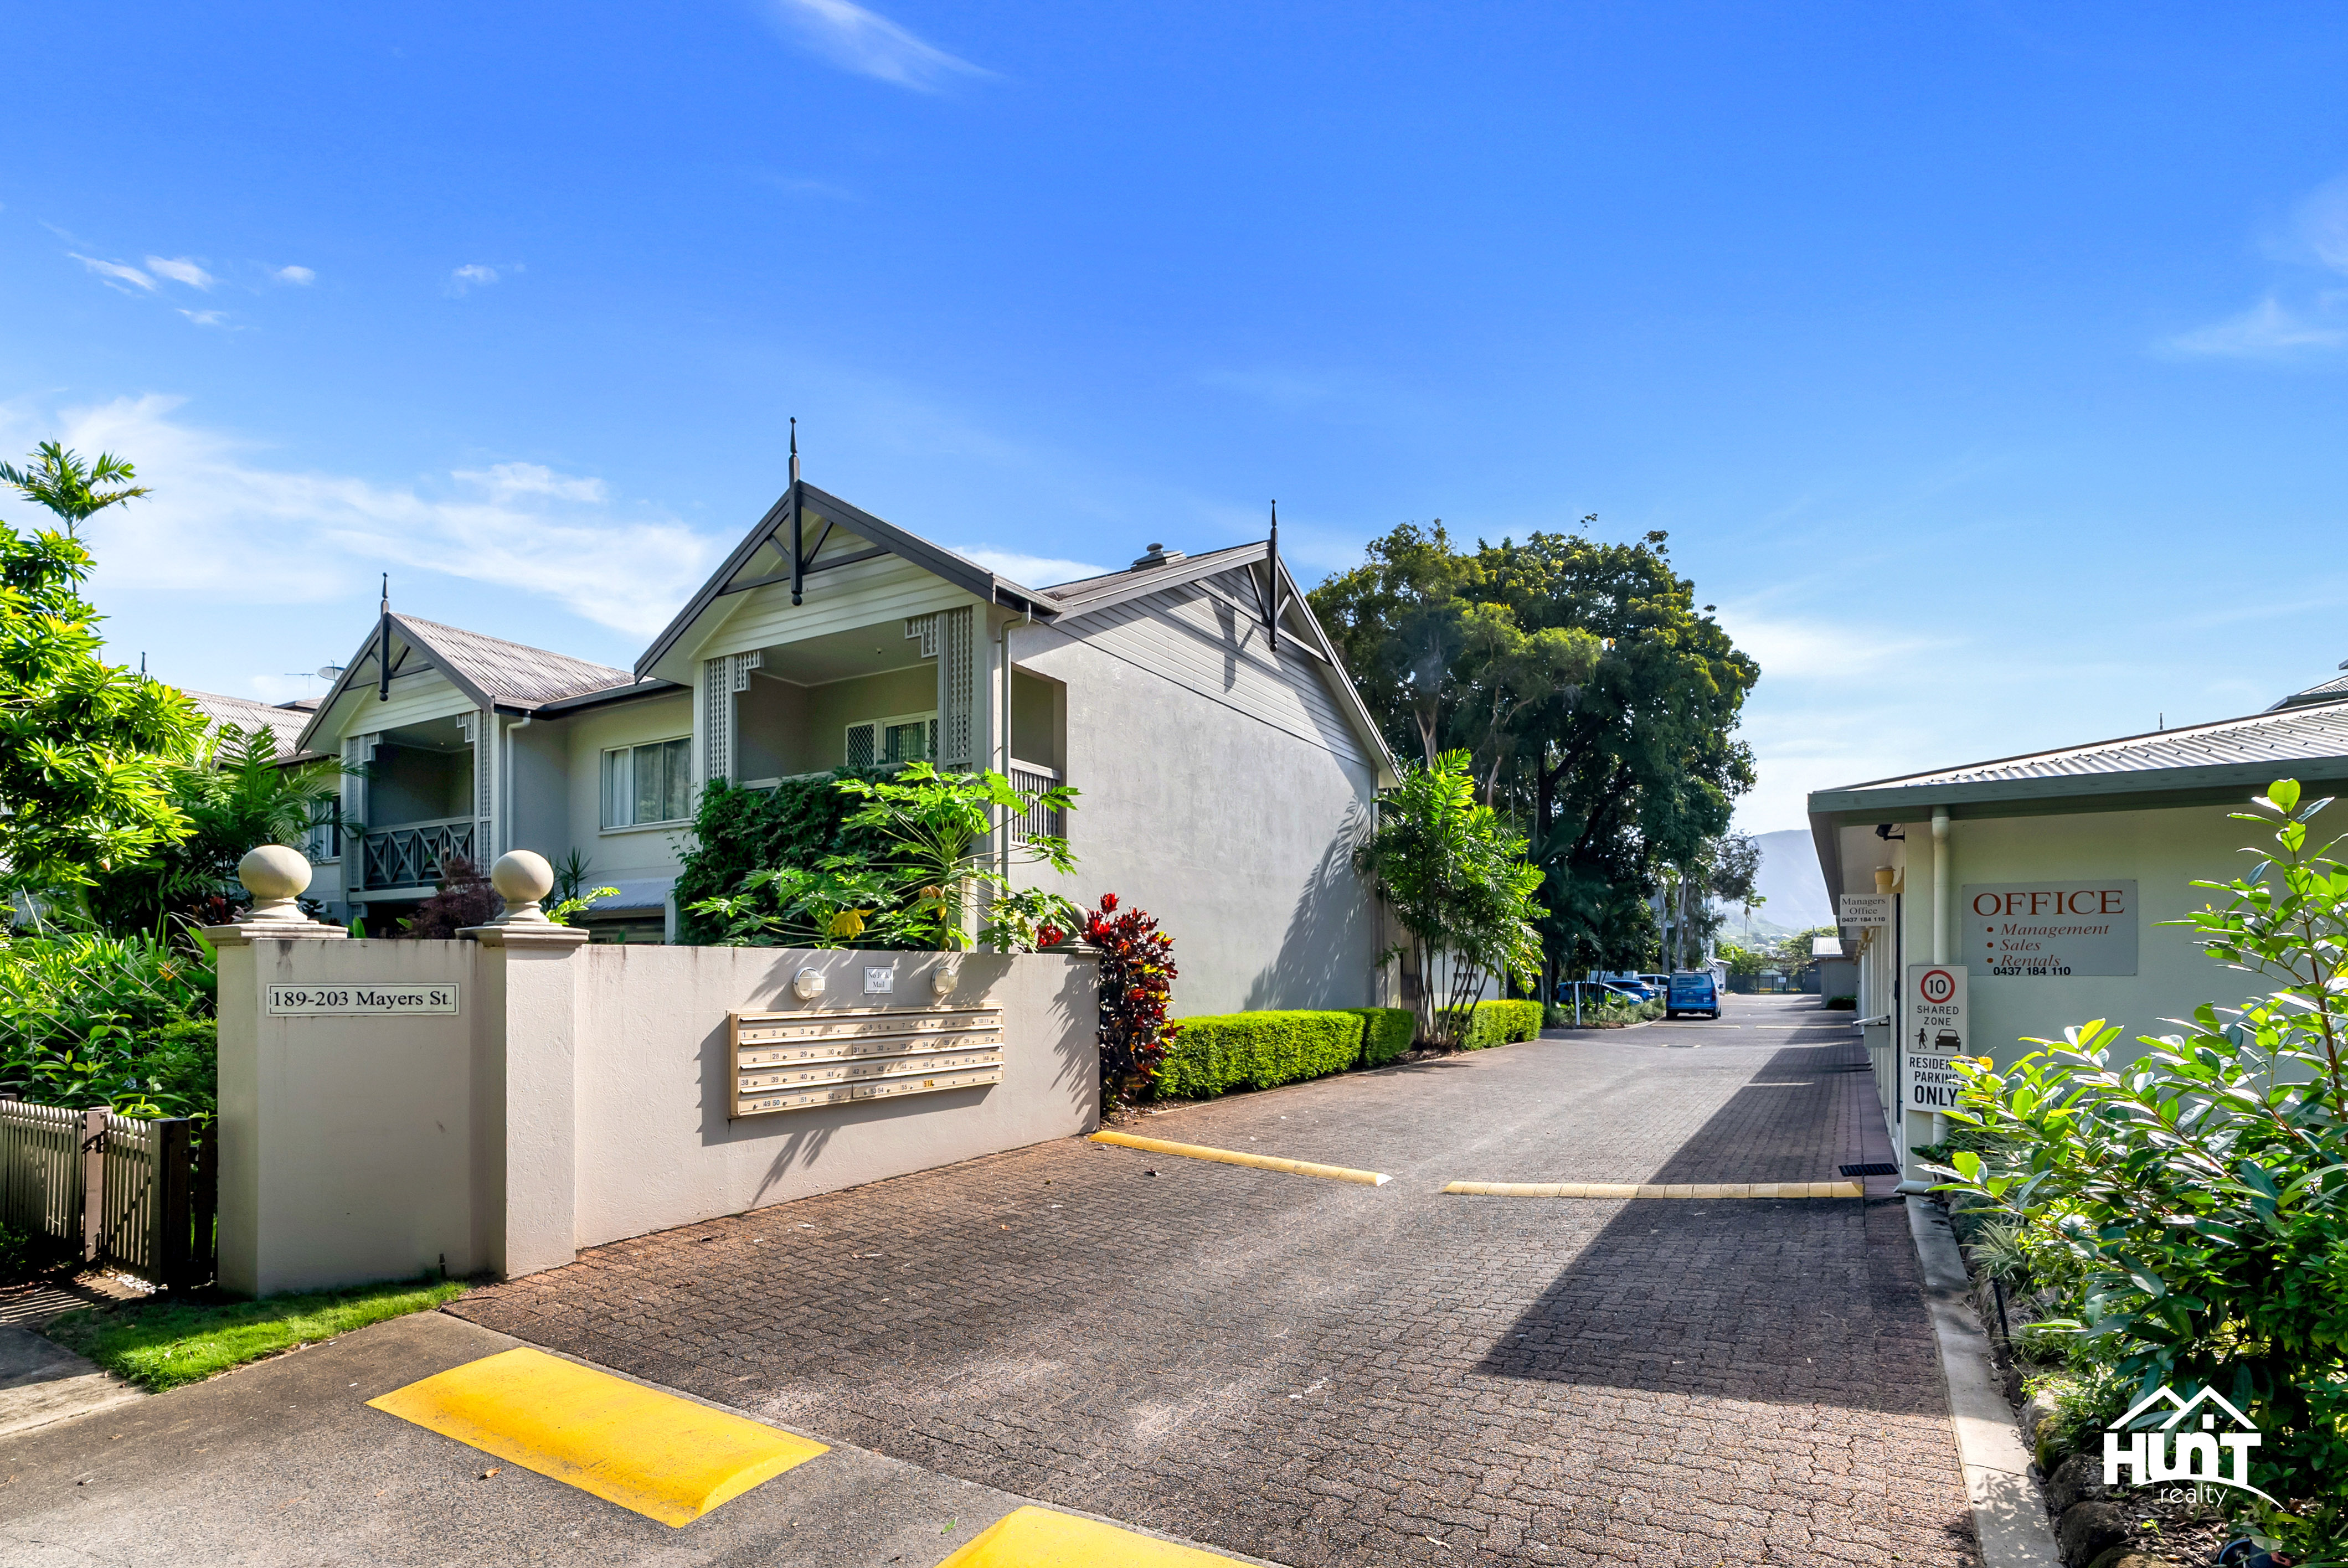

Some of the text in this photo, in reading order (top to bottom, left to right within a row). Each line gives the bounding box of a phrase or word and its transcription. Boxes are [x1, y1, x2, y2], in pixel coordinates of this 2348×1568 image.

[1842, 898, 1886, 906] Managers
[1973, 890, 2125, 916] OFFICE
[2000, 924, 2110, 938] Management
[2000, 939, 2041, 951] Sales
[2000, 955, 2061, 967] Rentals
[2026, 967, 2047, 975] 184
[2051, 967, 2071, 975] 110
[1929, 979, 1946, 994] 10
[274, 991, 452, 1009] 189-203 Mayers St.
[1917, 1005, 1959, 1014] SHARED
[1924, 1017, 1951, 1025] ZONE
[1909, 1057, 1965, 1070] RESIDEN
[1914, 1085, 1958, 1107] ONLY
